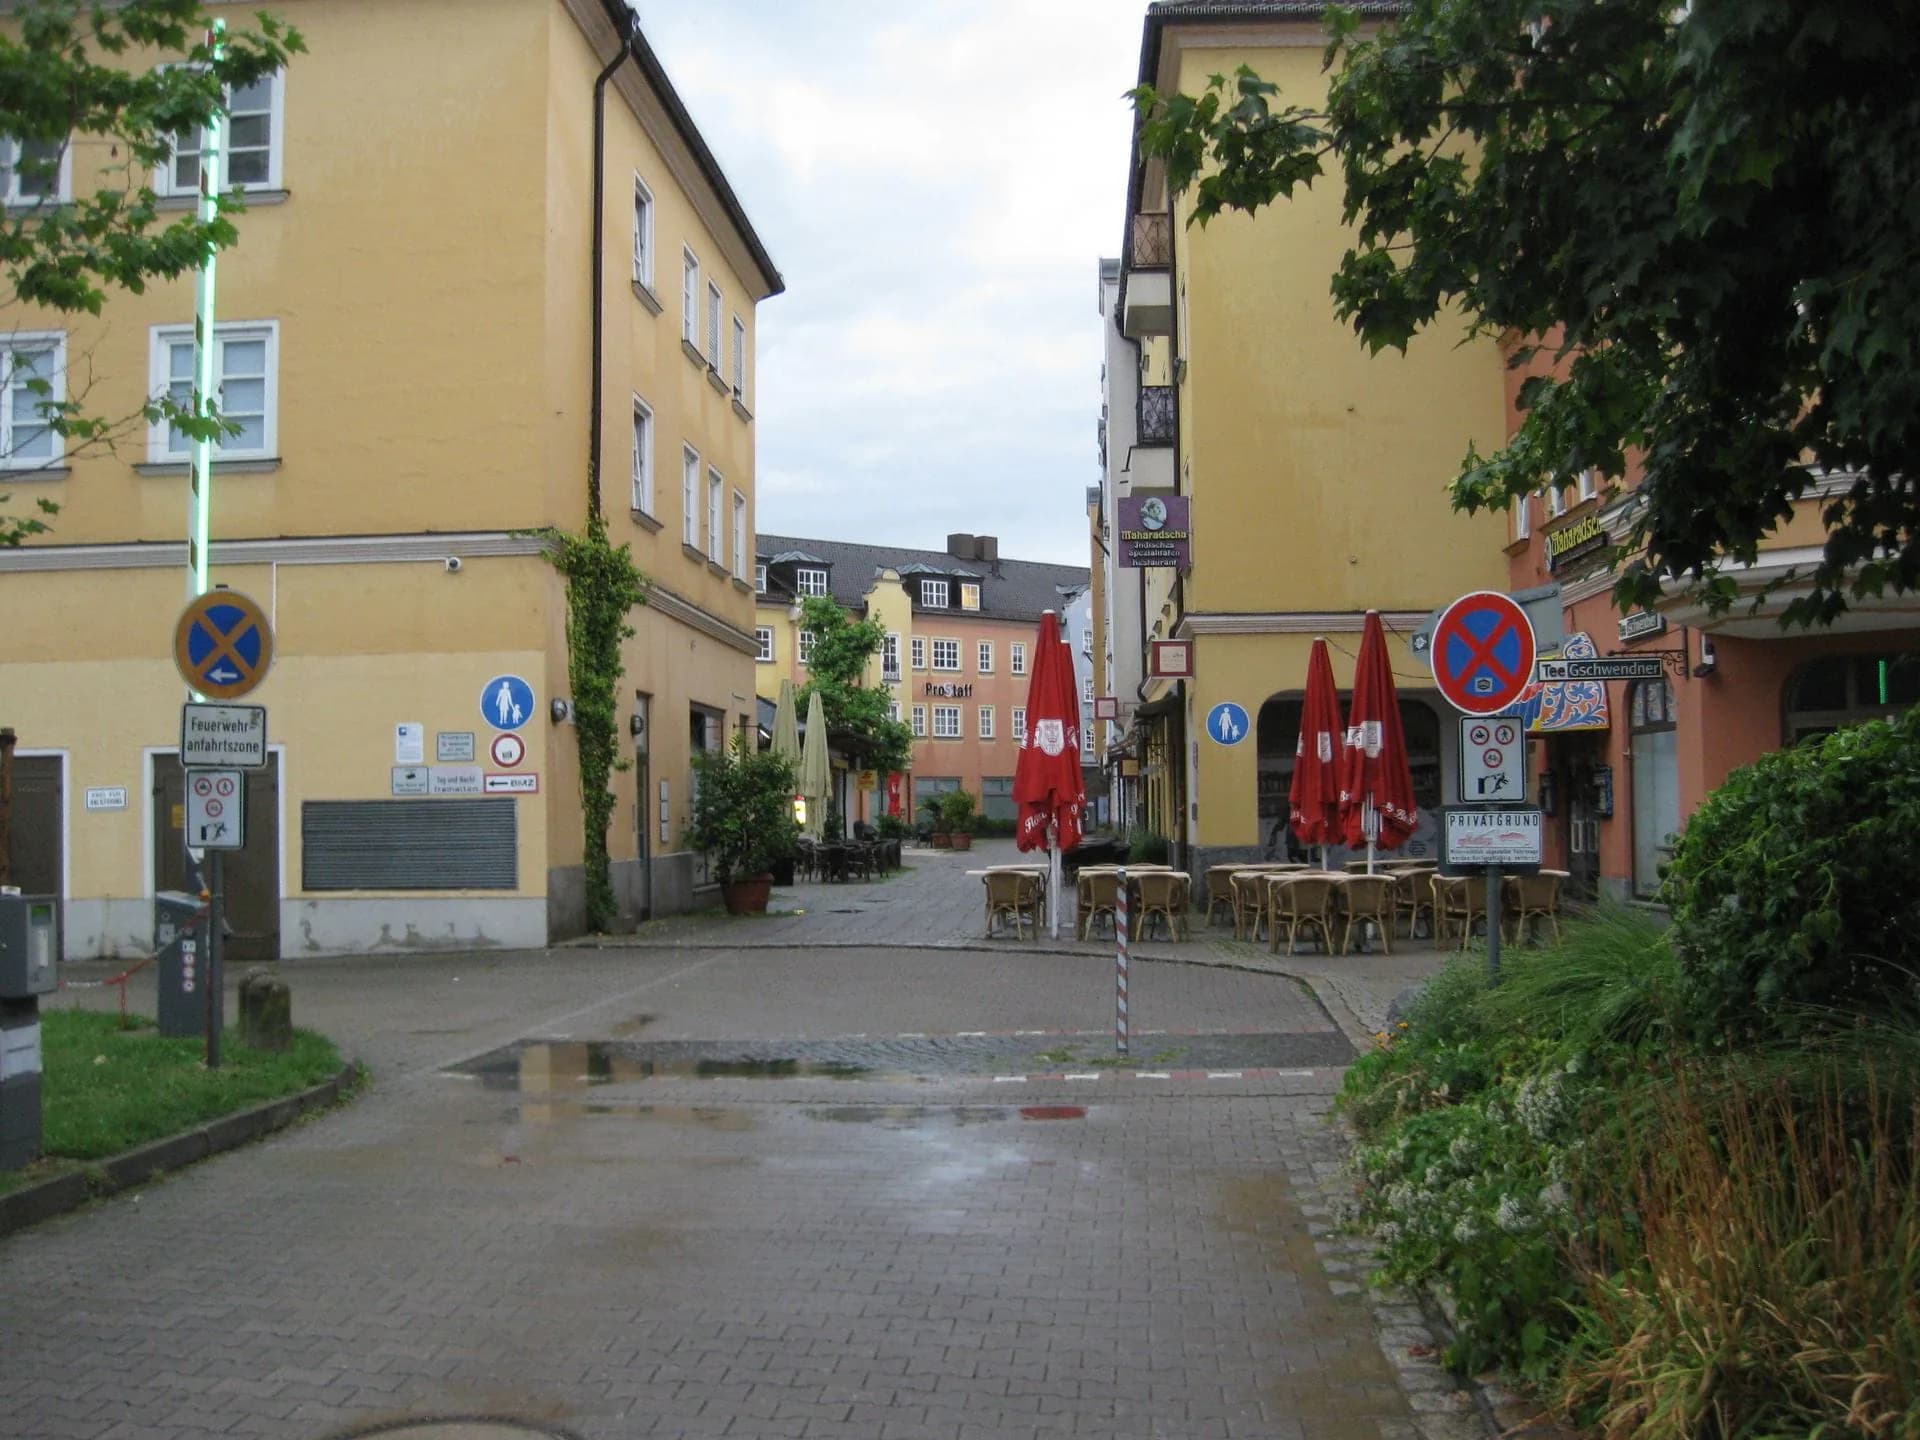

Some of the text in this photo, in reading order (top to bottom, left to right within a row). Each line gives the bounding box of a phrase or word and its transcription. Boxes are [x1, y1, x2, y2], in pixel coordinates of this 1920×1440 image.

[1121, 530, 1187, 540] Maharadscha
[1542, 661, 1660, 678] Tee Gschwendner
[925, 682, 972, 698] ProStaff
[187, 738, 260, 753] anfahrtszone
[1449, 814, 1538, 826] PRIVATGRUND
